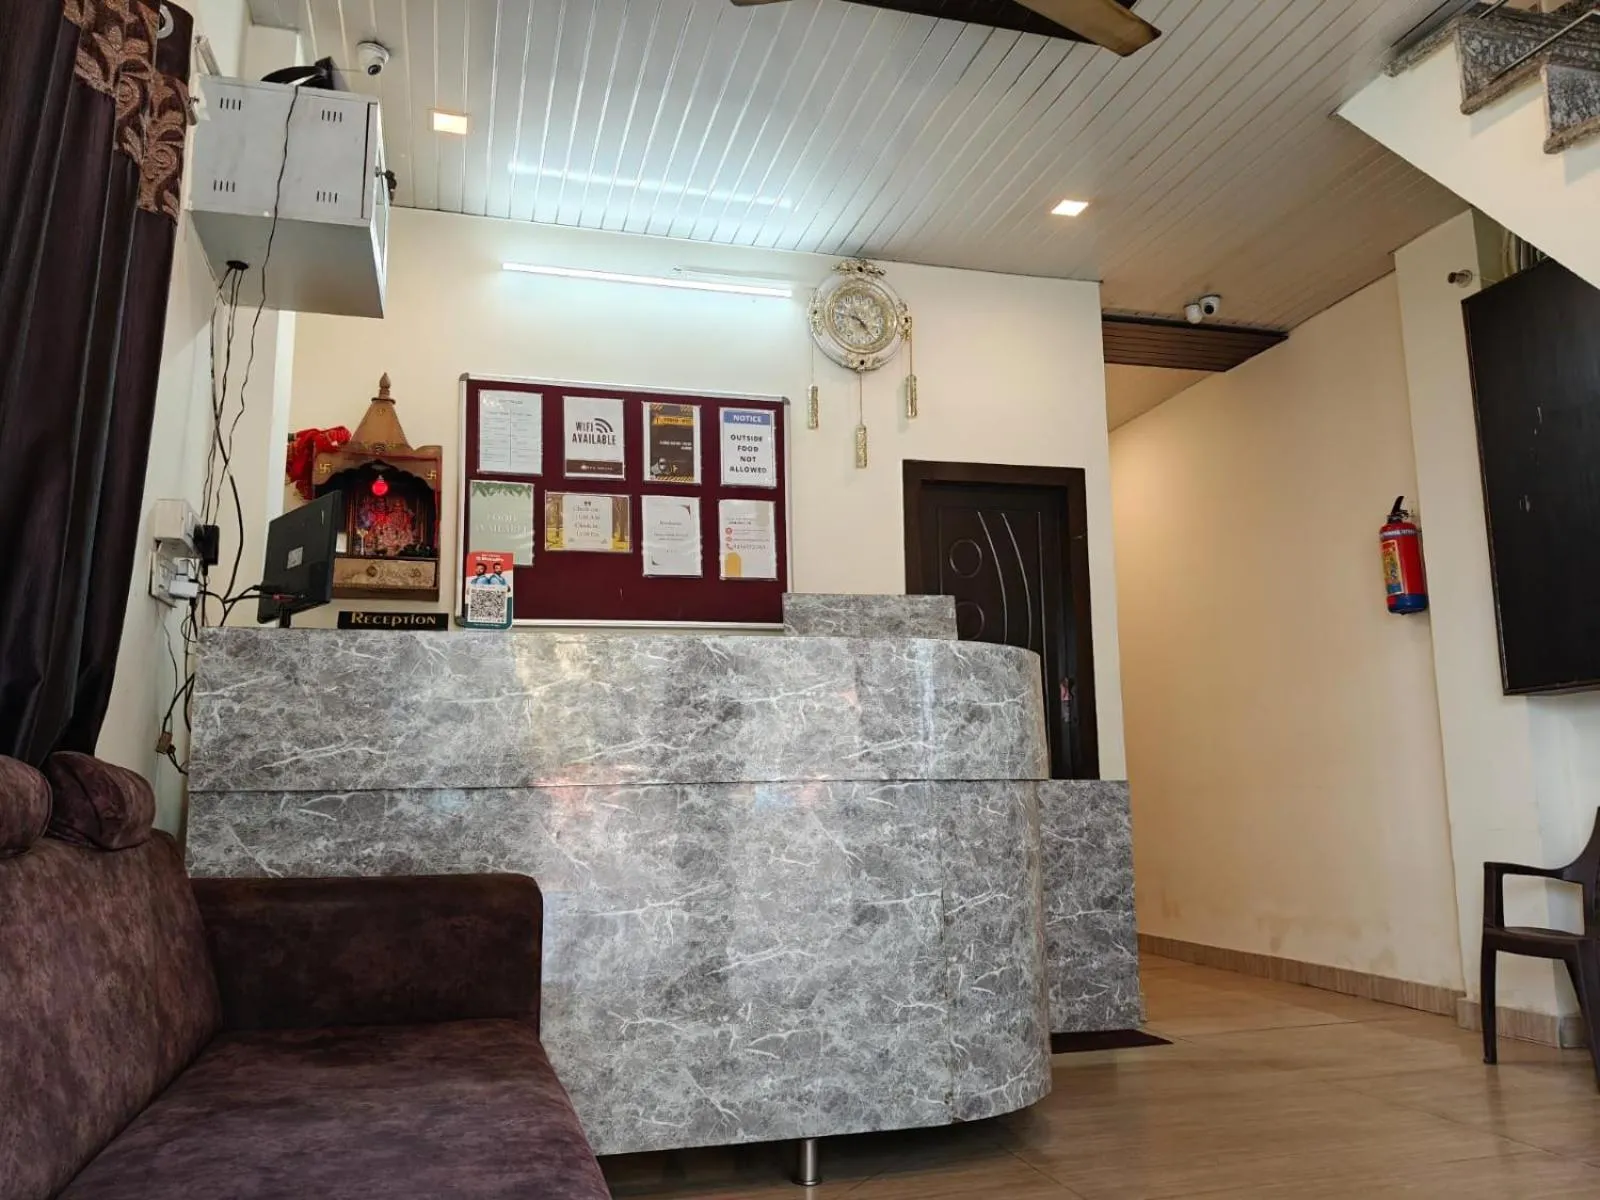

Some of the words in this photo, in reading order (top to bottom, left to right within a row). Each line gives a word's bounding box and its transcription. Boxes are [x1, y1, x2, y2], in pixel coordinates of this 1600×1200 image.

[733, 414, 762, 423] NOTICE
[576, 421, 594, 433] WIFI
[572, 432, 617, 446] AVAILABLE
[730, 434, 763, 442] OUTSIDE
